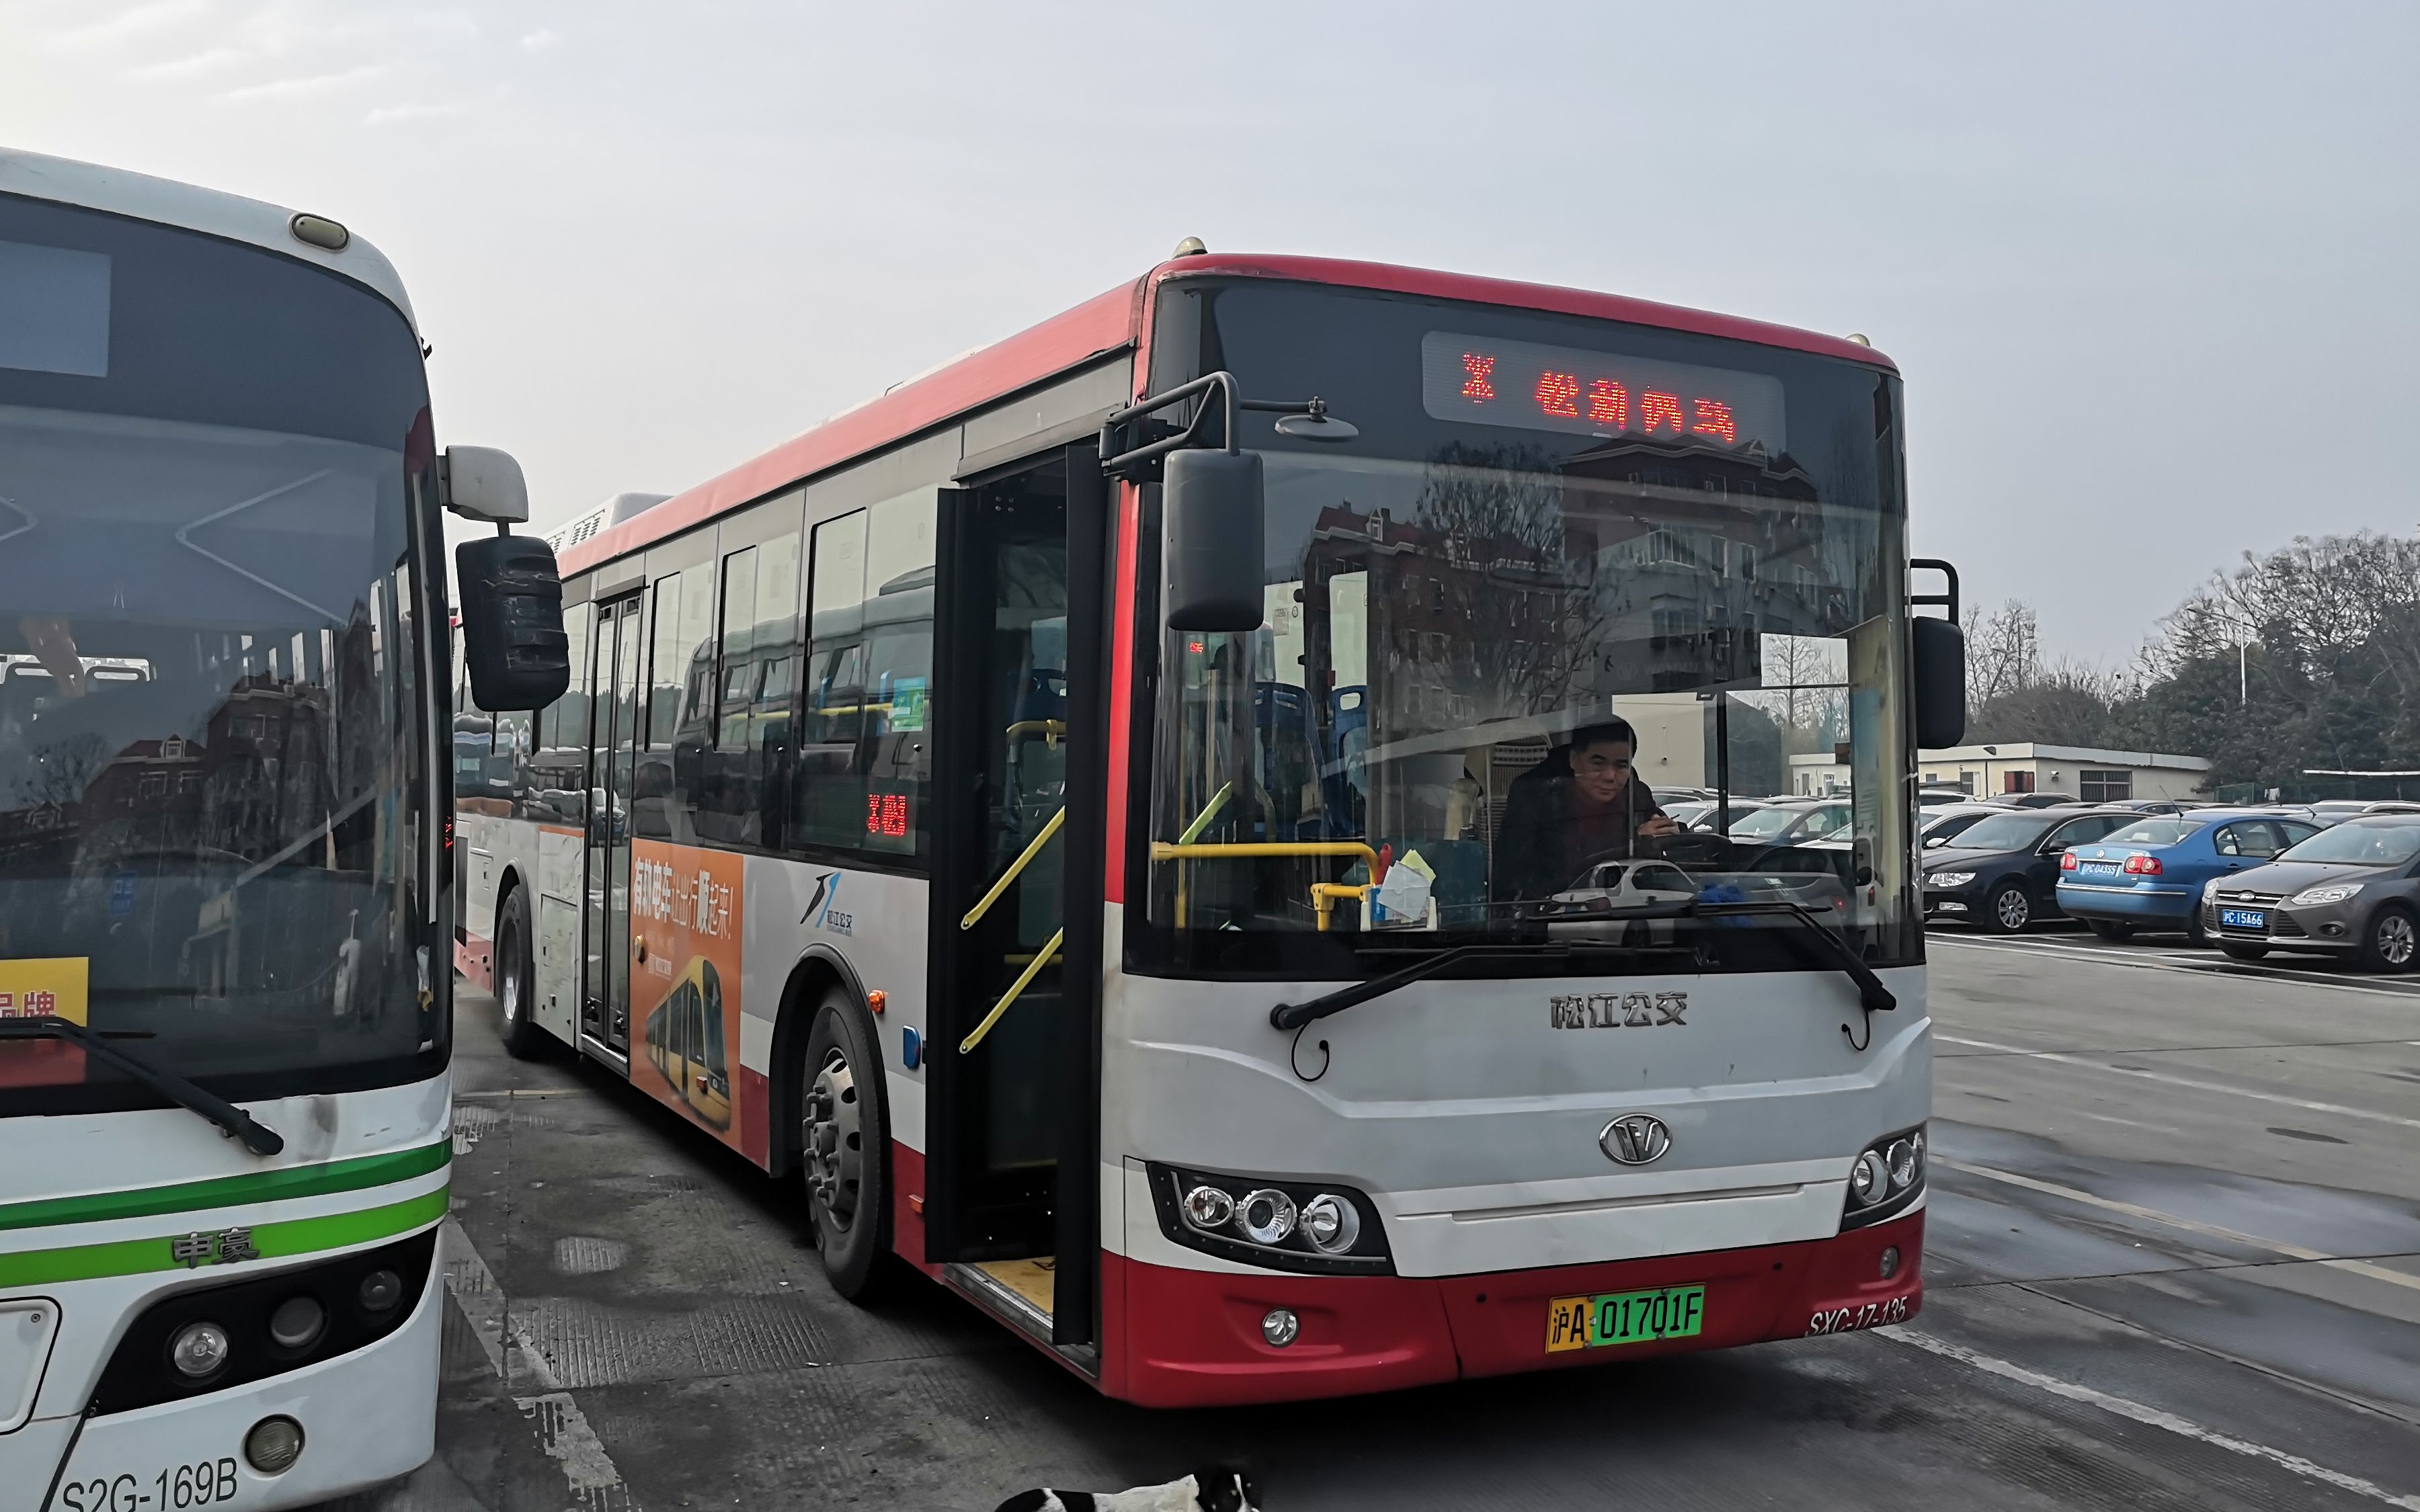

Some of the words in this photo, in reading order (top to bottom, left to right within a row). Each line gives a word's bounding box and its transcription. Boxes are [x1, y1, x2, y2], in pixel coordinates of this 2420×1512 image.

[1550, 991, 1687, 1030] 松江公交
[173, 1227, 259, 1269] 申豪
[1804, 1296, 1908, 1338] SXC-17-135
[63, 1457, 237, 1512] S2G-169B
